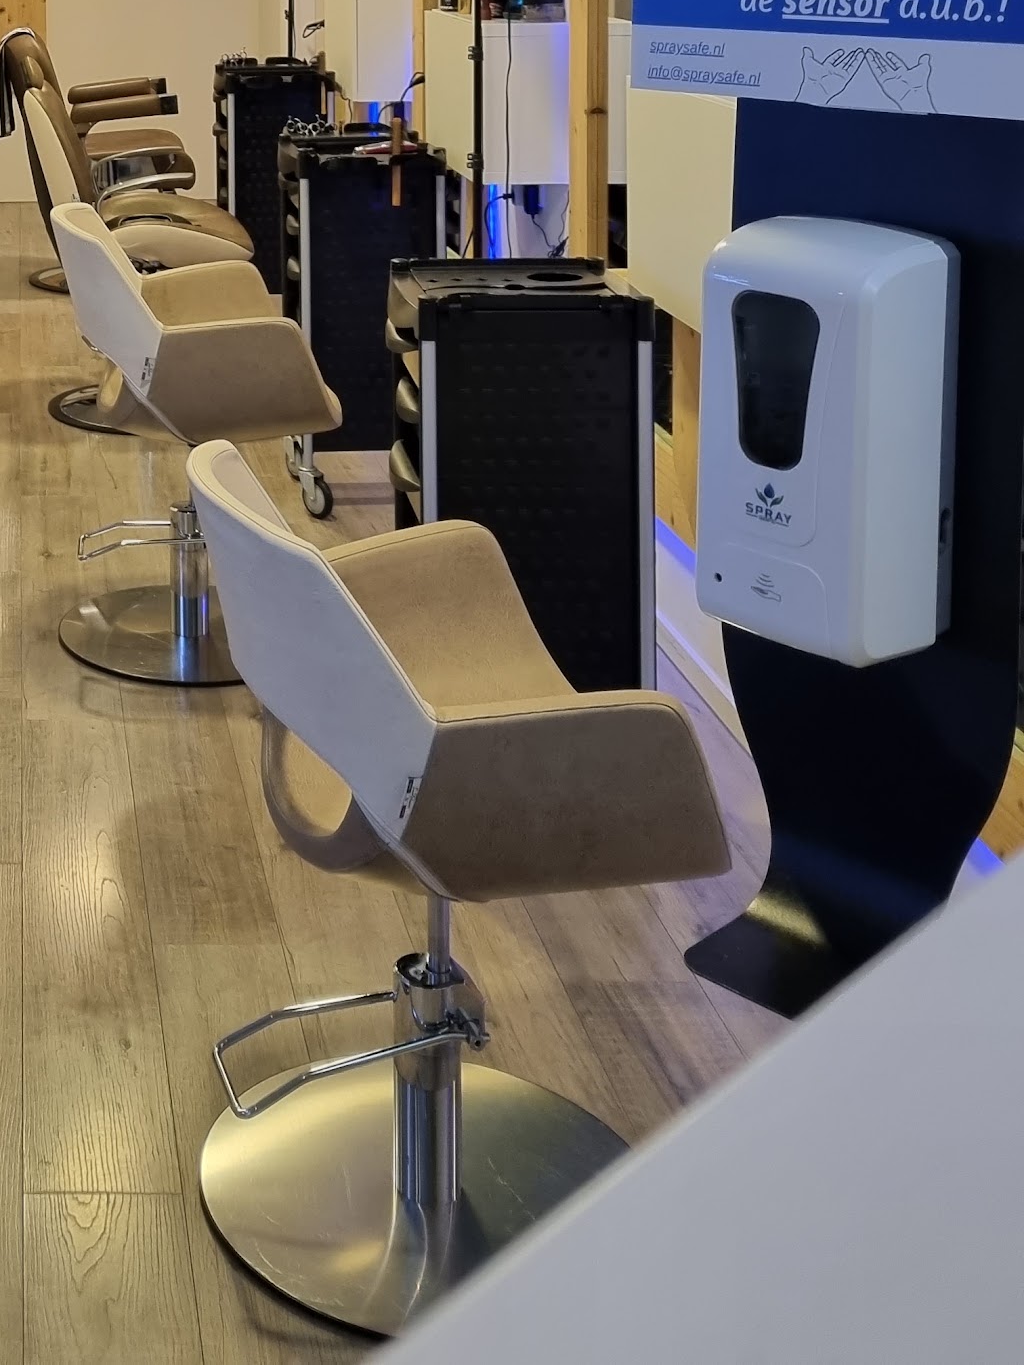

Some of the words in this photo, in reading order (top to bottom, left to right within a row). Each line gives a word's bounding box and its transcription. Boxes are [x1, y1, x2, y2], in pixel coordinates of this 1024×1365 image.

[649, 41, 726, 58] spraysafe.nl
[647, 64, 762, 87] info@spraysafe.nl
[745, 501, 792, 524] SPRAY
